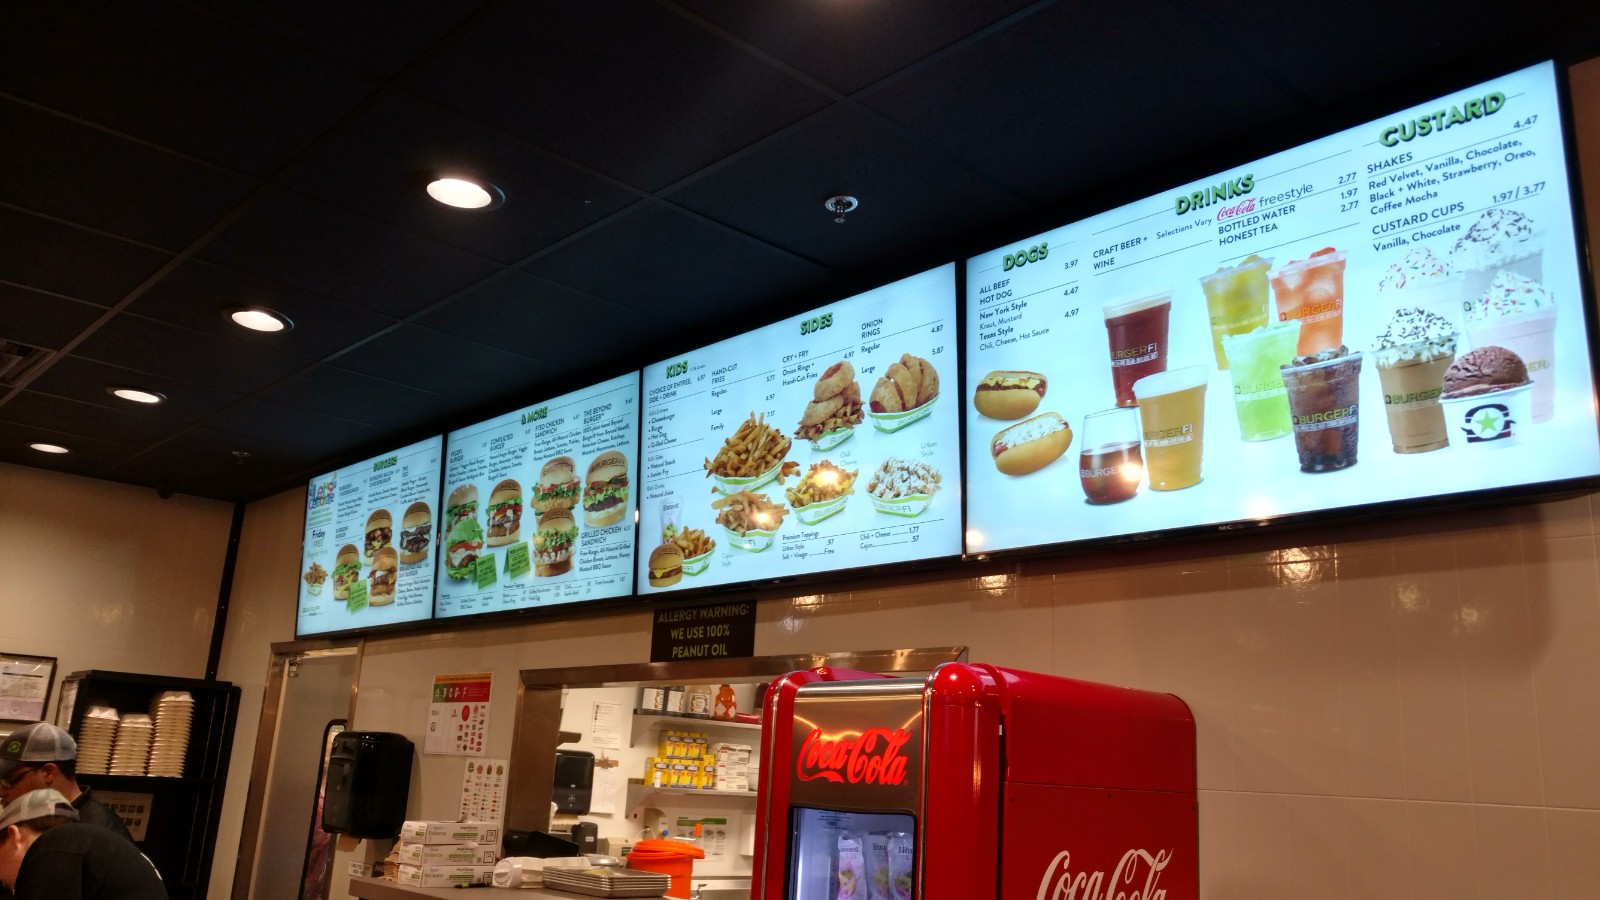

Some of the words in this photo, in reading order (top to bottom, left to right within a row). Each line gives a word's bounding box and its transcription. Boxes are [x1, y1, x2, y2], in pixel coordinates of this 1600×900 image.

[1379, 91, 1506, 147] CUSTARD
[1513, 115, 1538, 129] 4.47
[1367, 152, 1413, 174] SHAKES
[1369, 177, 1387, 190] Red
[1390, 168, 1423, 184] Velvet,
[1425, 156, 1463, 172] Vanilla,
[1466, 138, 1522, 160] Chocolate,
[1338, 172, 1356, 184] 2.77
[1370, 189, 1395, 203] Black
[1407, 177, 1440, 192] White,
[1442, 160, 1501, 181] Strawberry,
[1504, 149, 1536, 162] Oreo,
[1175, 174, 1255, 215] DRINKS
[1259, 183, 1313, 207] freestyle
[1341, 188, 1358, 199] 1.97
[1493, 190, 1513, 204] 1.97
[1523, 181, 1546, 196] 3.77
[1340, 201, 1358, 213] 2.77
[1370, 200, 1402, 215] Coffee
[1405, 190, 1438, 206] Mocha
[1218, 216, 1260, 235] BOTTLED
[1262, 205, 1296, 221] WATER
[1372, 212, 1428, 235] CUSTARD
[1431, 202, 1464, 219] CUPS
[1156, 223, 1193, 240] Selections
[1195, 218, 1212, 228] Vary
[1219, 226, 1258, 246] HONEST
[1260, 223, 1278, 236] TEA
[1373, 236, 1410, 252] Vanilla,
[1412, 223, 1461, 242] Chocolate
[1093, 243, 1119, 259] CRAFT
[1121, 239, 1142, 252] BEER
[1003, 242, 1049, 271] DOGS
[1094, 257, 1115, 270] WINE
[1064, 259, 1078, 270] 3.97
[980, 283, 992, 294] ALL
[993, 279, 1010, 290] BEEF
[1064, 286, 1079, 297] 4.47
[980, 294, 995, 306] HOT
[995, 289, 1012, 301] DOG
[980, 309, 993, 321] New
[994, 305, 1010, 317] York
[1011, 300, 1027, 313] Style
[1064, 308, 1079, 318] 4.97
[800, 312, 833, 336] SIDES
[861, 318, 883, 330] ONION
[980, 320, 997, 331] Kraut,
[998, 313, 1022, 325] Mustard
[861, 328, 880, 339] RINGS
[980, 330, 996, 341] Texas
[998, 326, 1014, 338] Style
[980, 340, 994, 351] Chili,
[995, 335, 1018, 347] Cheese,
[1019, 332, 1030, 341] Hot
[1032, 327, 1049, 338] Sauce
[860, 343, 880, 353] Regular
[932, 346, 944, 355] 5.87
[782, 354, 794, 364] CRY
[799, 350, 809, 359] FRY
[666, 360, 688, 379] KIDS
[712, 364, 737, 376] HAND-CUT
[783, 366, 798, 376] Onion
[799, 363, 811, 372] Rings
[861, 365, 875, 374] Large
[712, 376, 725, 385] FRIES
[783, 374, 805, 386] Hand-Cut
[806, 372, 818, 380] Fries
[649, 386, 666, 396] CHOICE
[663, 391, 677, 400] DRINK
[527, 406, 548, 424] MORE
[584, 408, 593, 417] THE
[593, 404, 612, 414] BEYOND
[546, 418, 564, 428] CHICKEN
[711, 423, 724, 432] Family
[535, 427, 557, 438] SANDWICH
[313, 529, 325, 540] Friday
[581, 530, 599, 539] GRILLED
[601, 526, 621, 535] CHICKEN
[782, 532, 800, 541] Premium
[801, 531, 819, 539] Toppings
[581, 537, 606, 546] SANDWICH
[658, 608, 698, 623] ALLERGY
[700, 603, 749, 619] WARNING:
[671, 628, 685, 640] WE
[687, 626, 704, 638] USE
[707, 624, 730, 637] 100%
[672, 644, 709, 658] PEANUT
[711, 643, 727, 655] OIL
